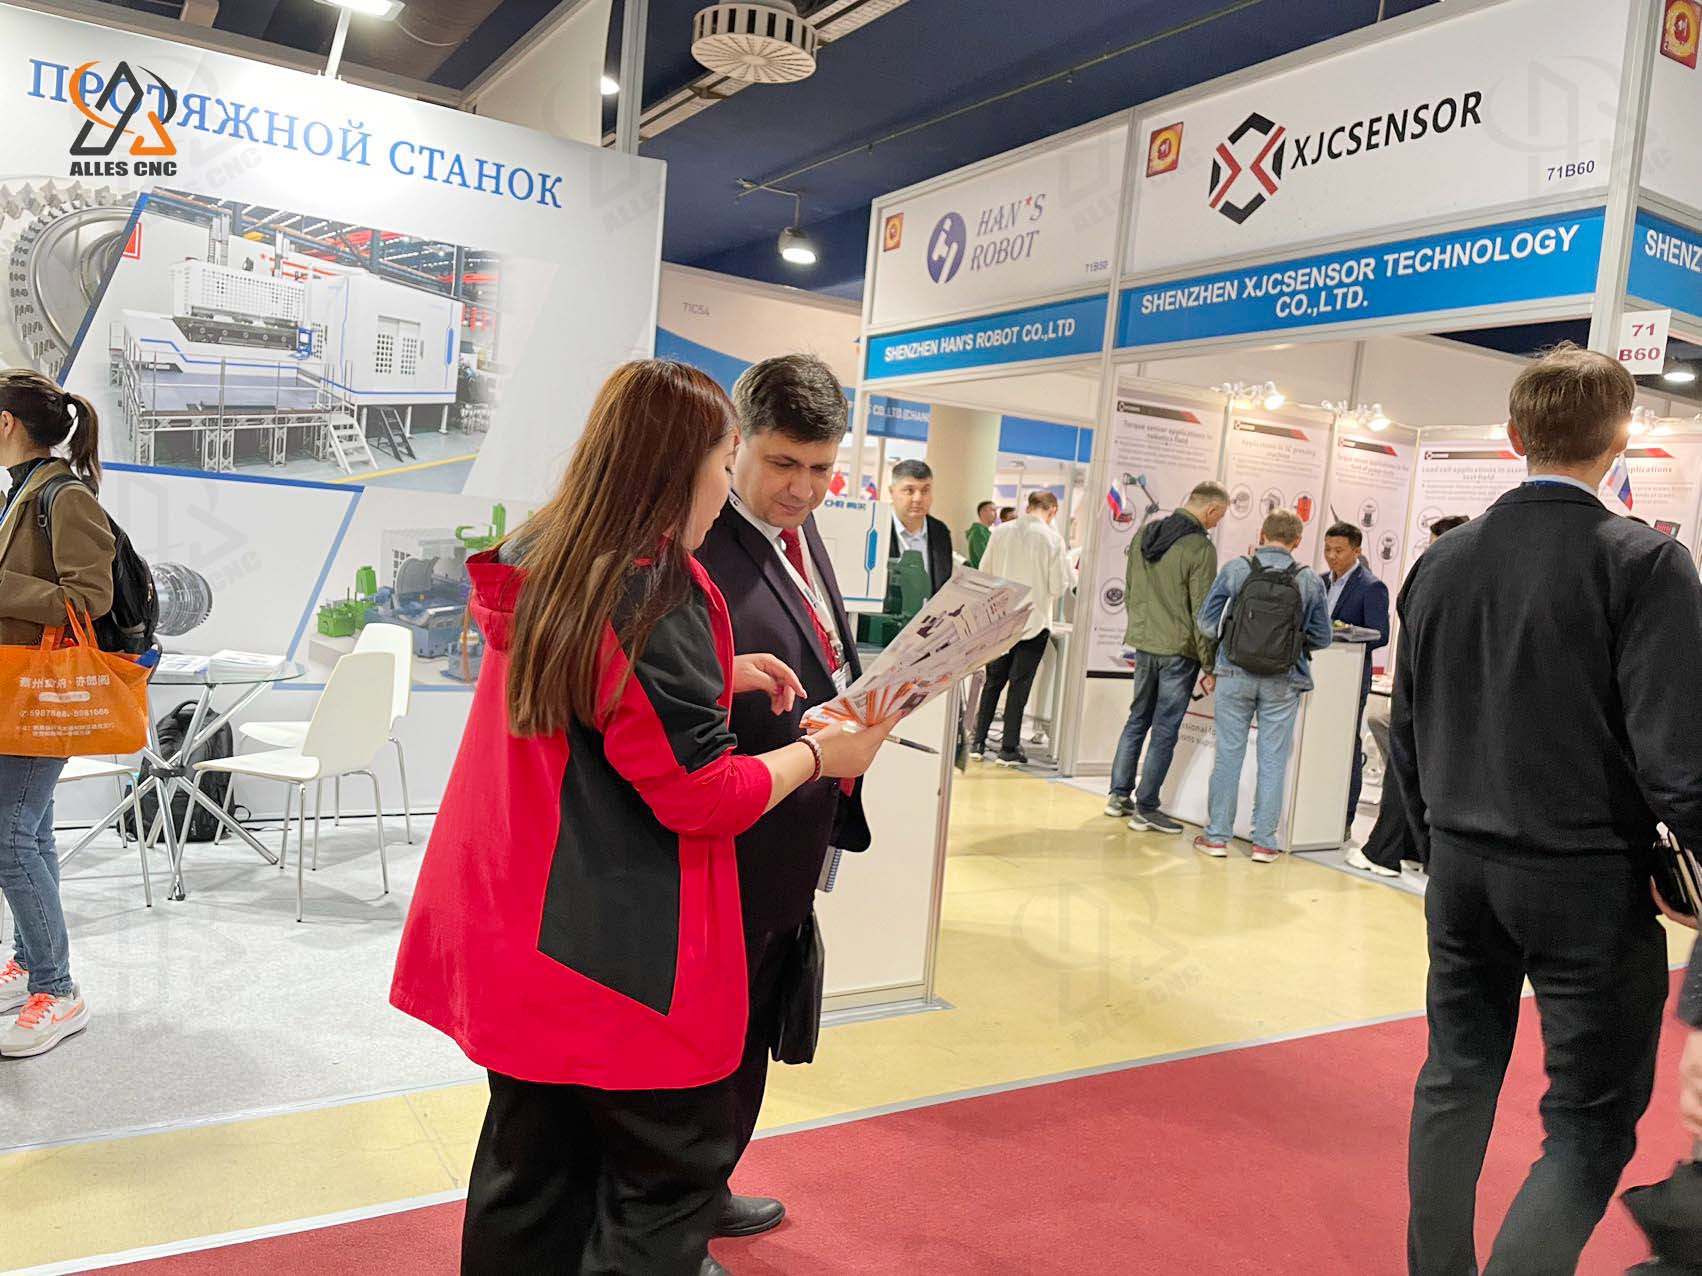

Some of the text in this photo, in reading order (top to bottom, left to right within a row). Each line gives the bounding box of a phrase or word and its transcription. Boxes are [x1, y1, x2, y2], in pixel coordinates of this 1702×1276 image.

[1290, 90, 1482, 170] XJCSENSOR
[389, 141, 563, 209] СТАНОК
[1546, 159, 1596, 181] 71B60
[970, 230, 1040, 272] ROBOT
[1140, 224, 1580, 315] SHENZHEN XJCSENSOR TECHNOLOGY
[1274, 286, 1369, 320] CO.,LTD.
[884, 317, 1076, 362] SHENZHEN HAN'S ROBOT CO.,LTD
[1631, 322, 1656, 337] 71
[1617, 347, 1661, 362] B60
